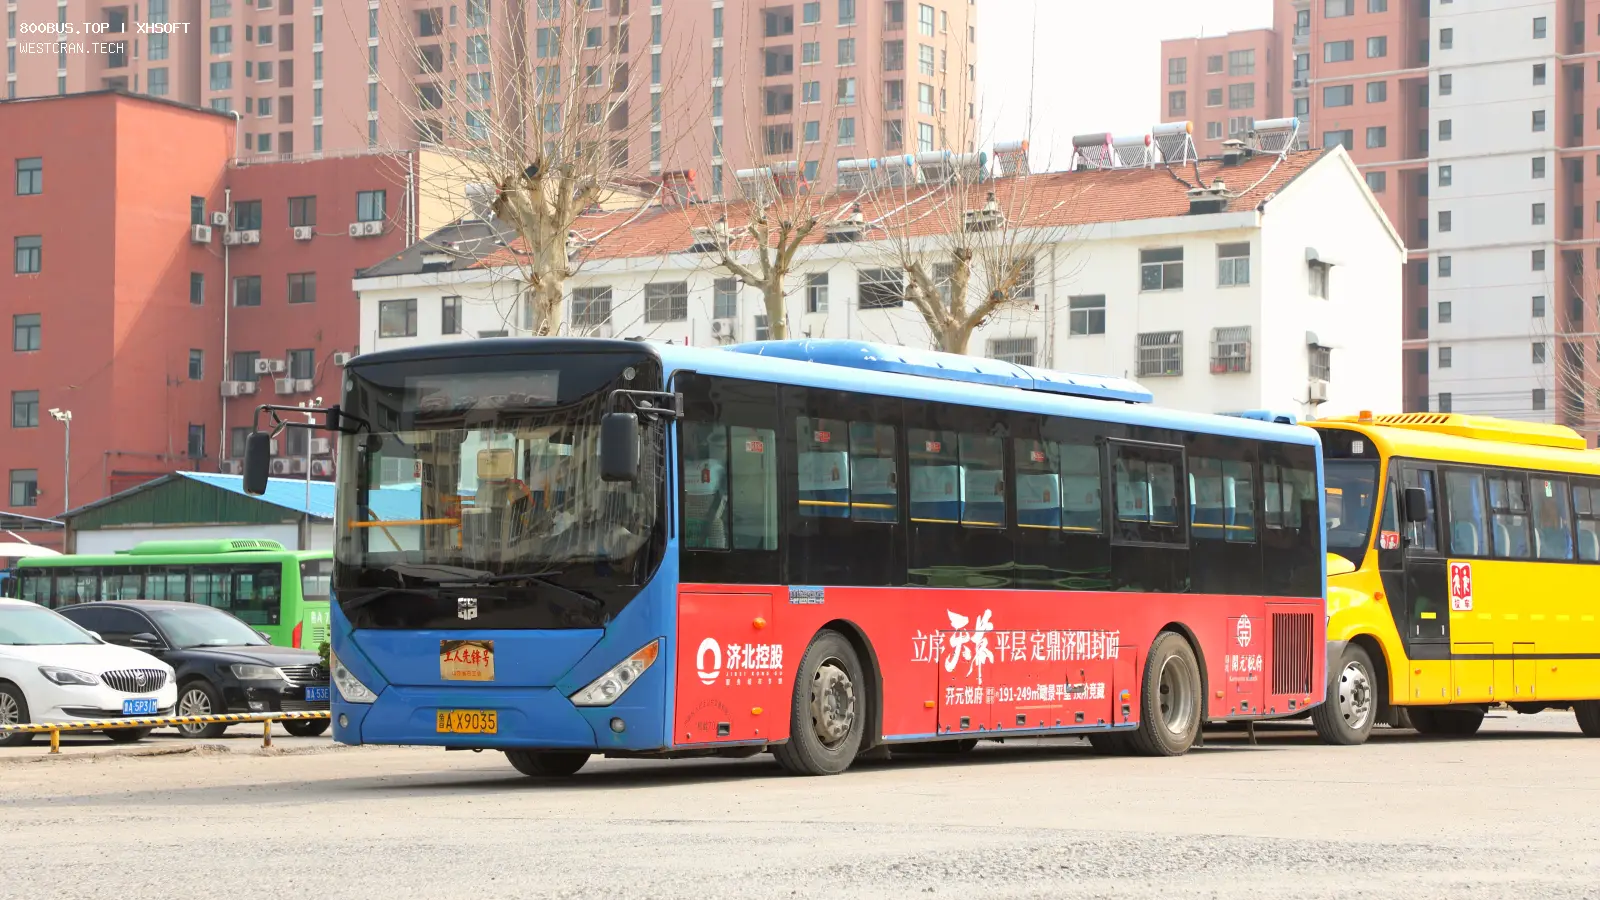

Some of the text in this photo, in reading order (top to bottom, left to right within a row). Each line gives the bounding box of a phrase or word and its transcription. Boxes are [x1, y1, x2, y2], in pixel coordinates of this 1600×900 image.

[726, 643, 783, 670] 济北控股
[1030, 628, 1120, 662] 定鼎济阳封面
[443, 648, 490, 668] 工人先锋号
[945, 685, 984, 705] 开元悦府
